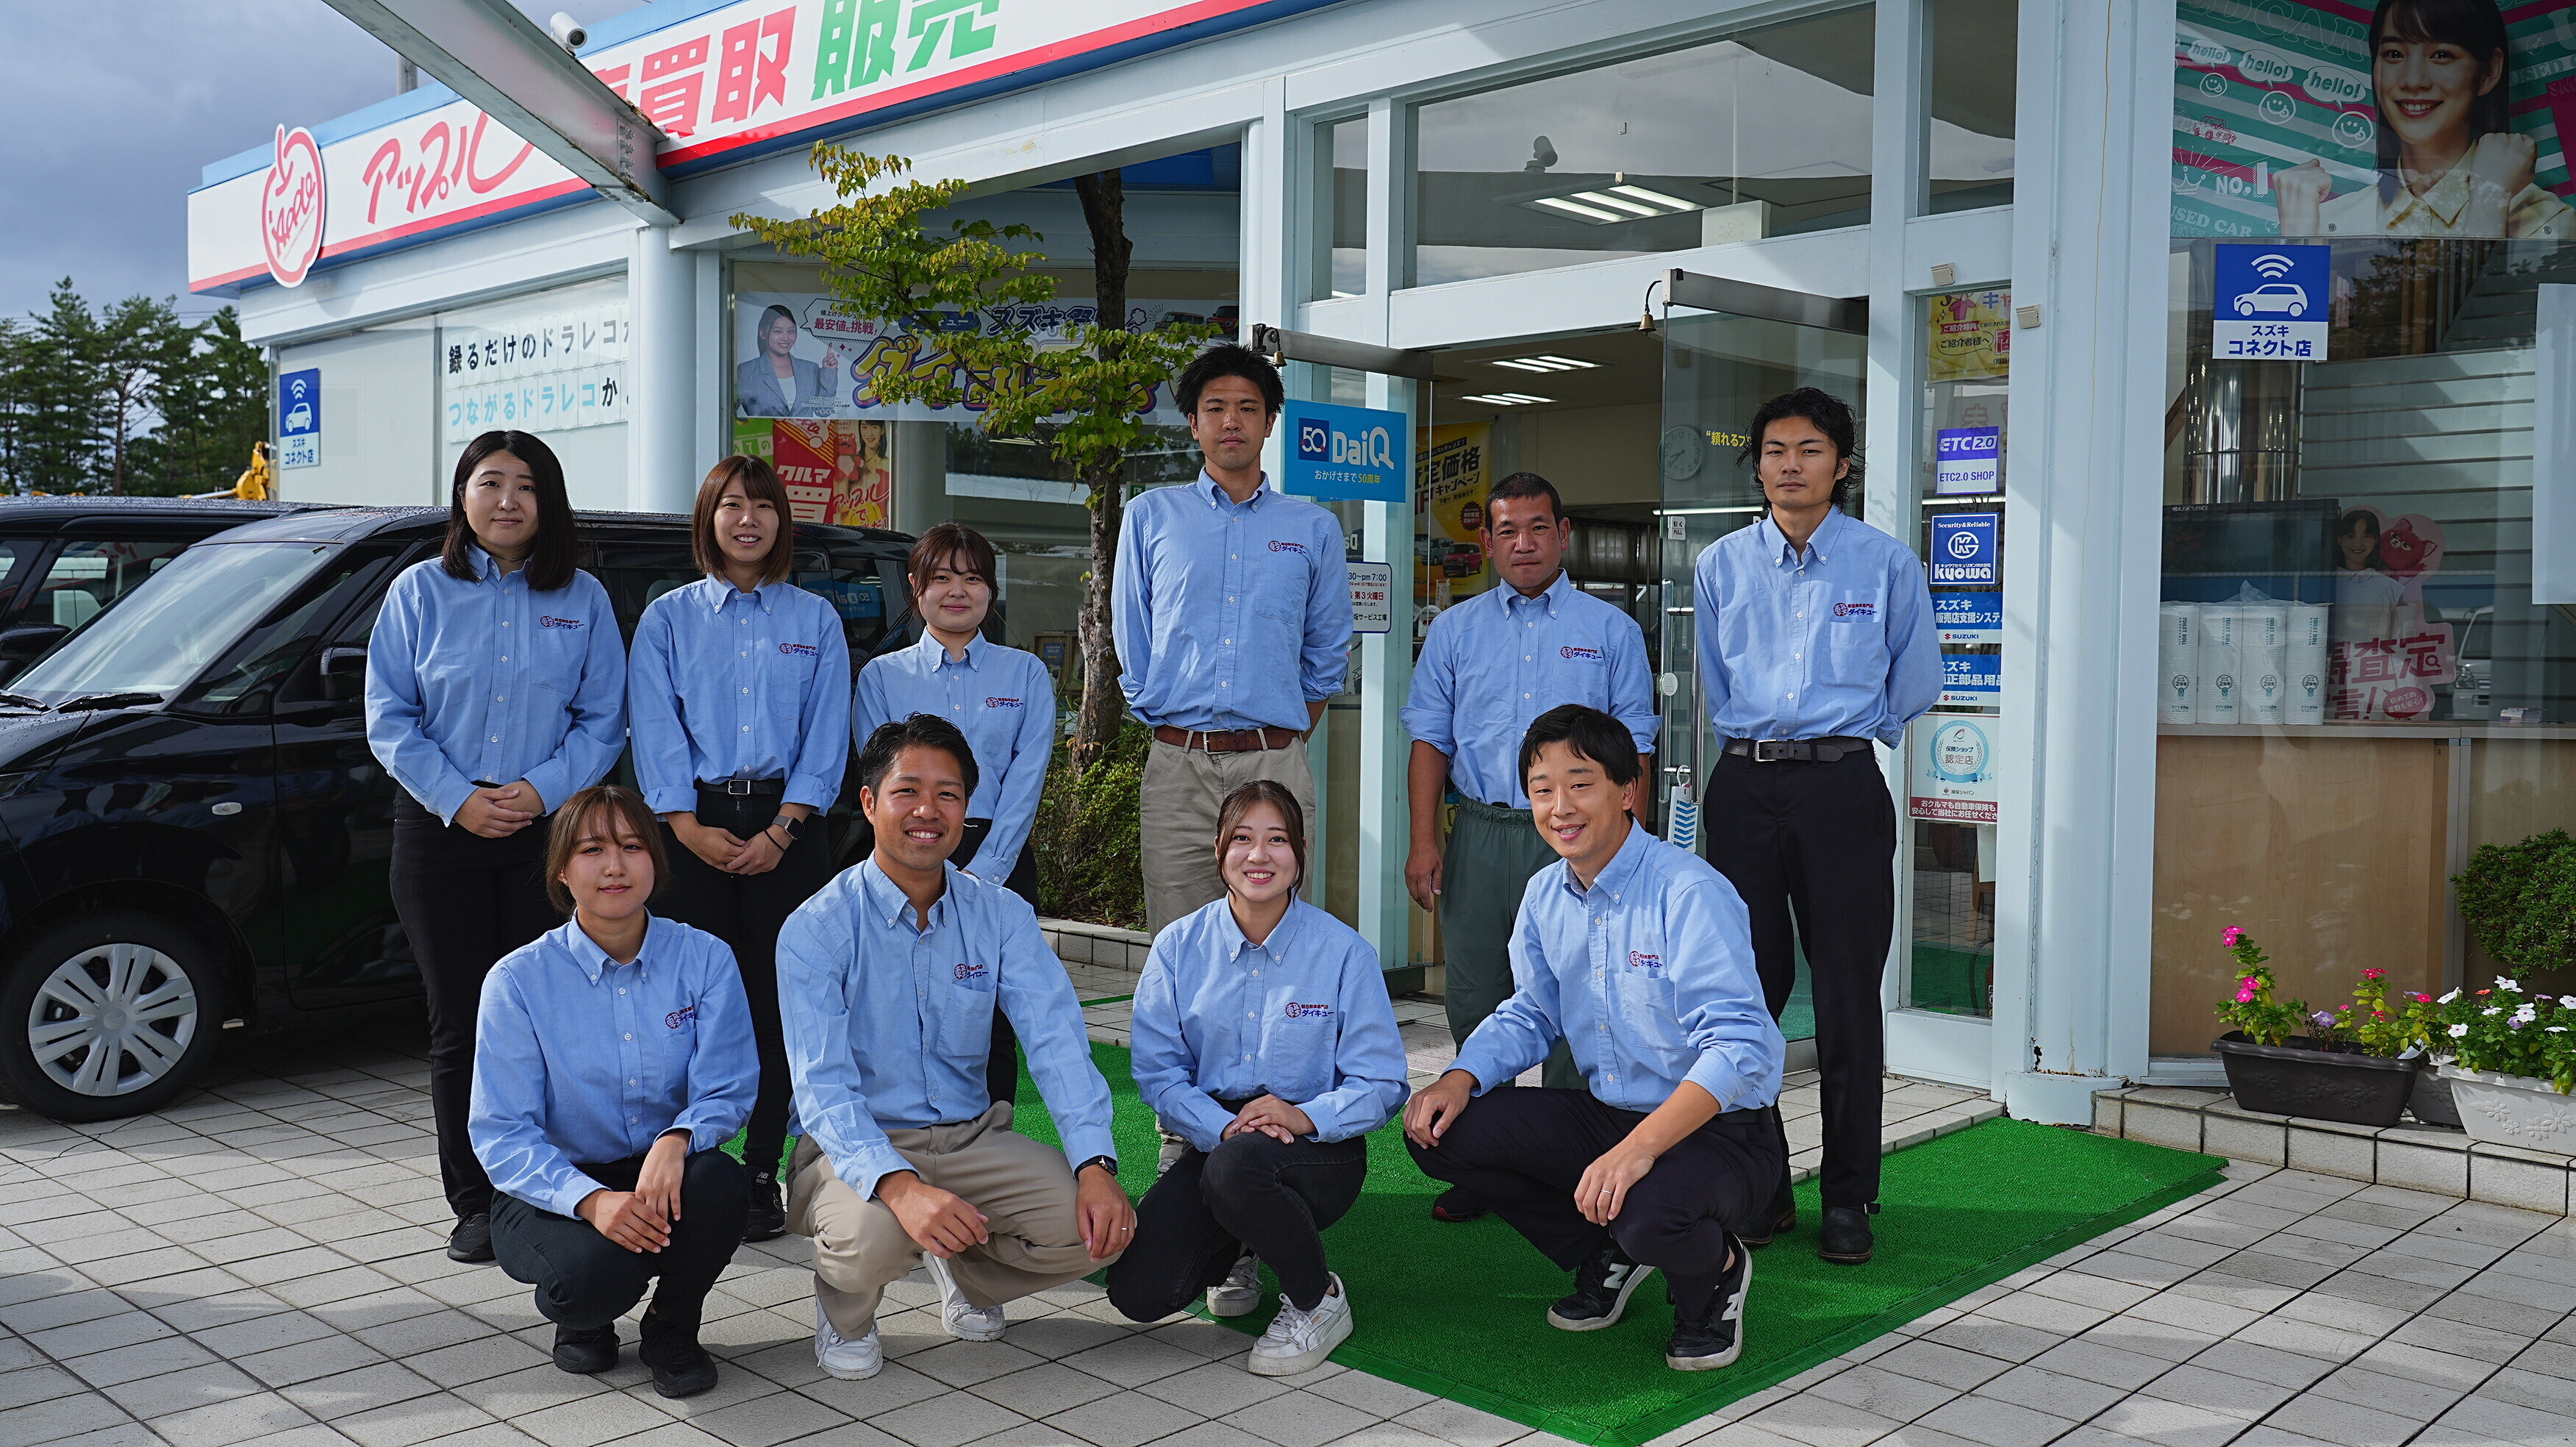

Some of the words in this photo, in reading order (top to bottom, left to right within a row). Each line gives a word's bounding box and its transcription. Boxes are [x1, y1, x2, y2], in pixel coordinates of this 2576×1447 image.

[2254, 0, 2366, 62] CAR
[2191, 43, 2228, 62] hello!
[2243, 54, 2289, 79] hello!
[2309, 71, 2361, 99] hello!
[362, 110, 534, 225] アップル
[594, 6, 796, 138] 買取
[2251, 324, 2290, 337] スズキ
[1940, 337, 1990, 349] ご紹介者様へ
[2228, 338, 2313, 357] コネクト店
[448, 376, 629, 427] つながるドラレコか
[1332, 426, 1395, 471] DaiQ
[285, 449, 314, 465] コネクト店
[776, 465, 831, 484] クルマ
[1314, 469, 1358, 483] おかげさまで
[1358, 473, 1382, 485] 50周年
[1939, 472, 1969, 482] ETC2.0
[1971, 471, 1994, 481] SHOP
[1436, 471, 1481, 496] キャンペーン
[1281, 546, 1307, 554] ダイキュー
[1372, 573, 1387, 582] 7:00
[1934, 563, 1992, 581] kyowa
[1936, 599, 1973, 611] スズキ
[1935, 612, 2003, 624] 販売店支援システ
[555, 622, 585, 630] ダイキュー
[793, 648, 819, 657] ダイキュー
[1574, 651, 1603, 660] ダイキュー
[2389, 691, 2416, 704] 初めての
[1945, 754, 1974, 765] 認定店
[1921, 799, 1996, 812] おクルマも自動車保険も
